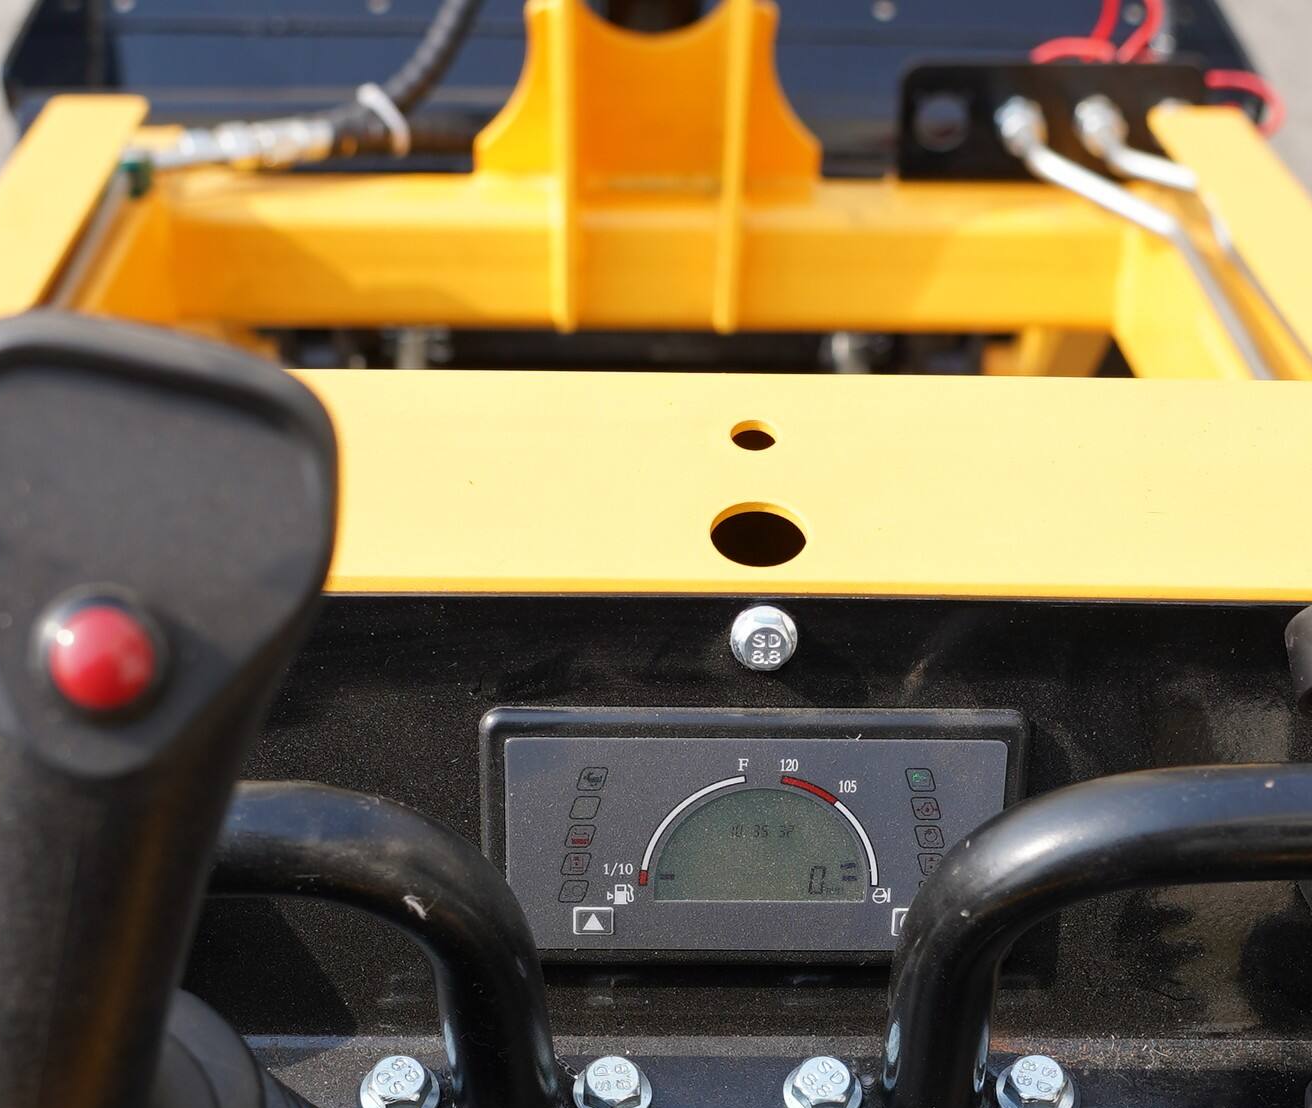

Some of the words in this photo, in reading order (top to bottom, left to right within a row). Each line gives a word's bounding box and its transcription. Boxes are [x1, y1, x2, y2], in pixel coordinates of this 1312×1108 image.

[752, 633, 782, 648] SD
[751, 650, 781, 664] 8.8
[738, 758, 749, 772] F
[780, 758, 799, 773] 120
[838, 780, 857, 794] 105
[604, 863, 633, 877] 1/10
